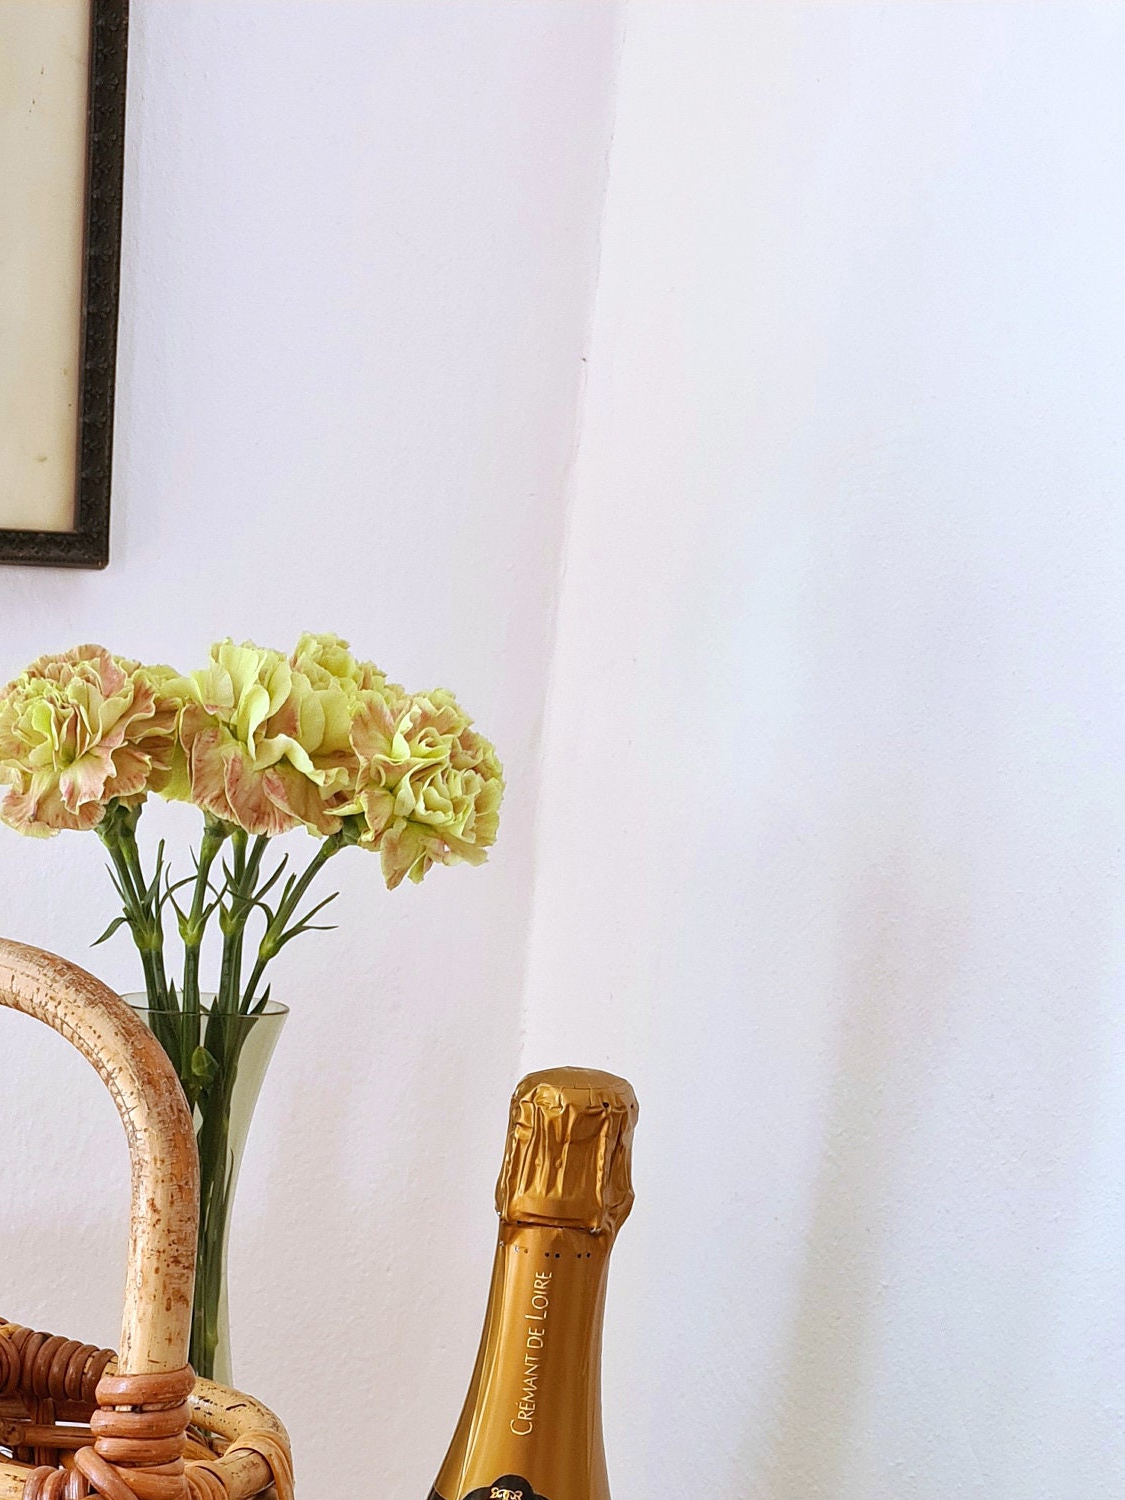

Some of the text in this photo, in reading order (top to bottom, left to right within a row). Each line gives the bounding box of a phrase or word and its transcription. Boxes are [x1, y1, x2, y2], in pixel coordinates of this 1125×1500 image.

[510, 1271, 553, 1436] CRÉMANT DE LOIRE
